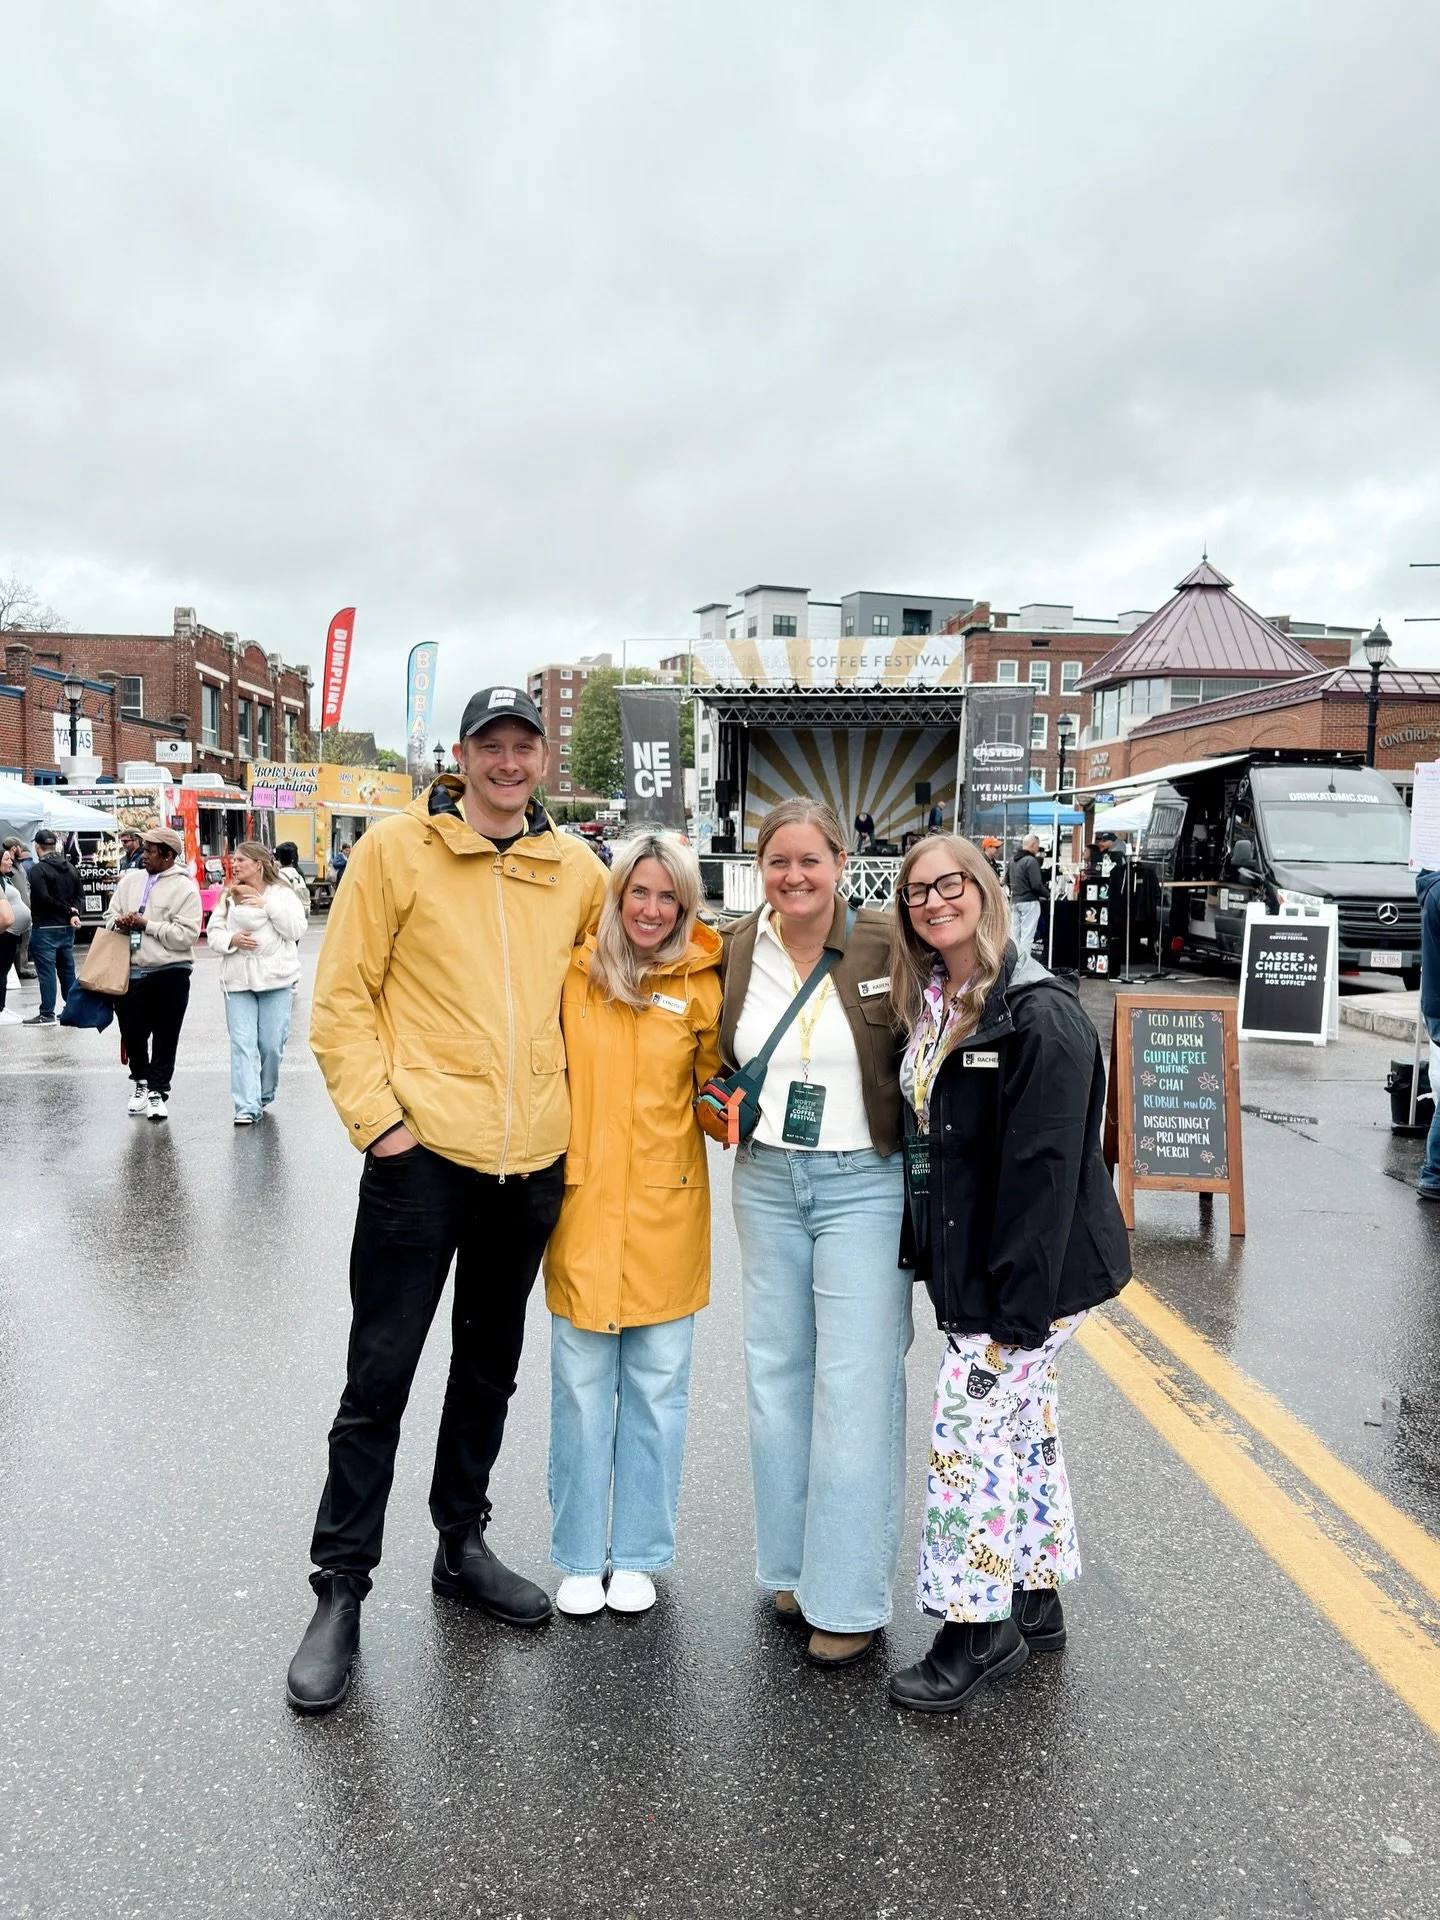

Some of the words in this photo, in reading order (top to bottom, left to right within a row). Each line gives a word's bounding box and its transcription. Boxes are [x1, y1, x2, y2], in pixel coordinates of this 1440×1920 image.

[806, 656, 868, 668] COFFEE
[875, 655, 949, 668] FESTIVAL
[325, 628, 348, 715] DUMPLING
[412, 650, 432, 733] BOBA
[56, 728, 91, 749] YAAS
[1379, 730, 1428, 749] CONCORD
[632, 741, 670, 769] NE
[973, 747, 1024, 758] EASTERN
[255, 766, 287, 778] BOBA
[287, 766, 306, 778] Tea
[309, 767, 316, 777] &
[634, 770, 672, 798] CF
[971, 784, 991, 792] LIVE
[993, 784, 1023, 792] MUSIC
[101, 797, 128, 807] weddngs
[134, 797, 150, 805] more
[980, 793, 1013, 801] SERI
[1289, 792, 1380, 803] DRINKATOMIC.COM
[1259, 951, 1305, 962] PASSES
[1255, 961, 1318, 972] CHECK-IN
[1148, 1014, 1169, 1027] ICED
[1151, 1032, 1174, 1047] COLD
[1176, 1034, 1203, 1047] BREW
[1143, 1050, 1178, 1065] GLUTEN
[1181, 1051, 1207, 1065] FREE
[1155, 1064, 1189, 1074] MUFFINS
[1159, 1078, 1184, 1091] CHAI
[794, 1098, 817, 1107] NORTH
[1143, 1094, 1179, 1109] REDBULL
[790, 1112, 817, 1122] FESTIVAL
[792, 1108, 816, 1117] COFFEE
[1143, 1115, 1210, 1130] DISGUSTINGLY
[1156, 1131, 1174, 1143] PRO
[1176, 1132, 1210, 1145] WOMEN
[1156, 1145, 1190, 1159] MERCH
